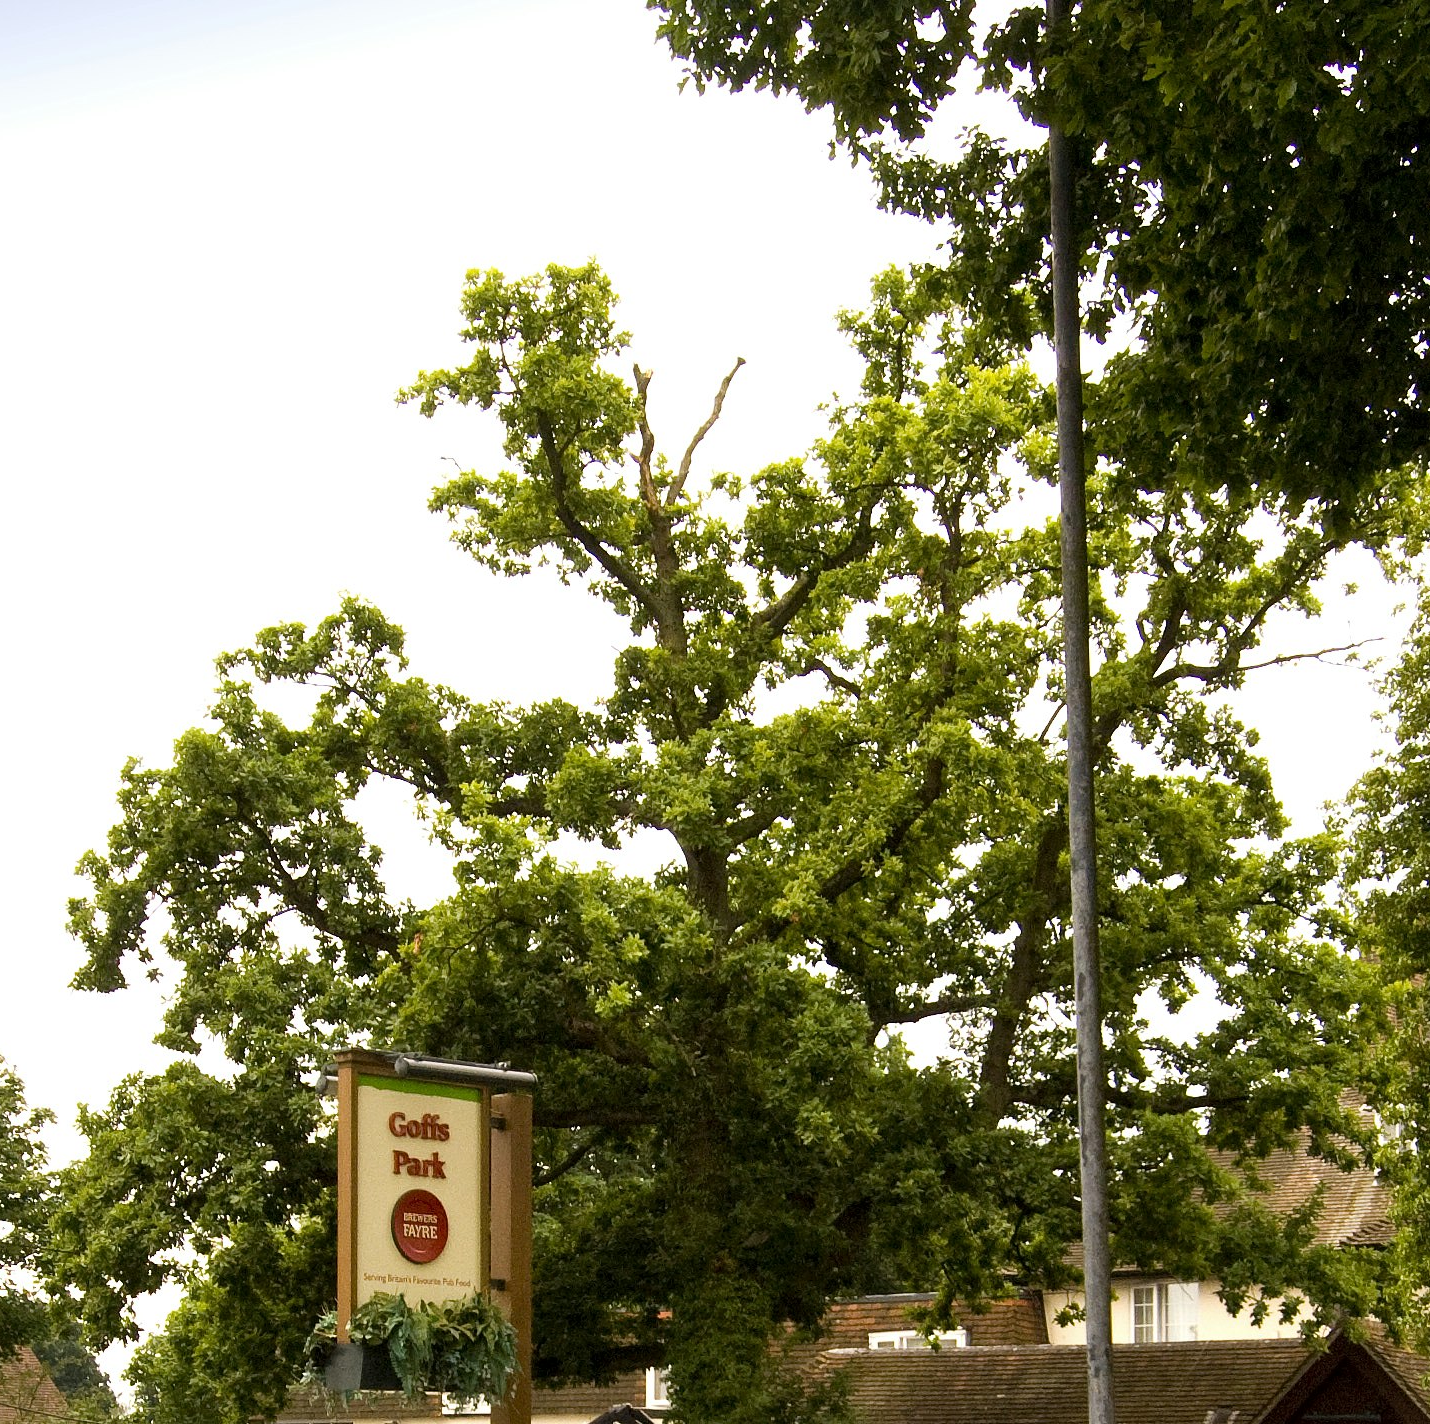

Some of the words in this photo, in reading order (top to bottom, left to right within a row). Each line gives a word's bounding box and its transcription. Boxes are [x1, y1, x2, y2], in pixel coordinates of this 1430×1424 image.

[388, 1111, 450, 1141] Goffs
[392, 1149, 447, 1179] Park
[403, 1212, 438, 1224] BREWERS
[403, 1223, 438, 1239] FAYRE
[363, 1273, 387, 1284] Serving
[387, 1274, 412, 1284] Britain's
[413, 1276, 441, 1285] Favourite
[442, 1277, 455, 1286] Pub
[455, 1278, 471, 1287] Food
